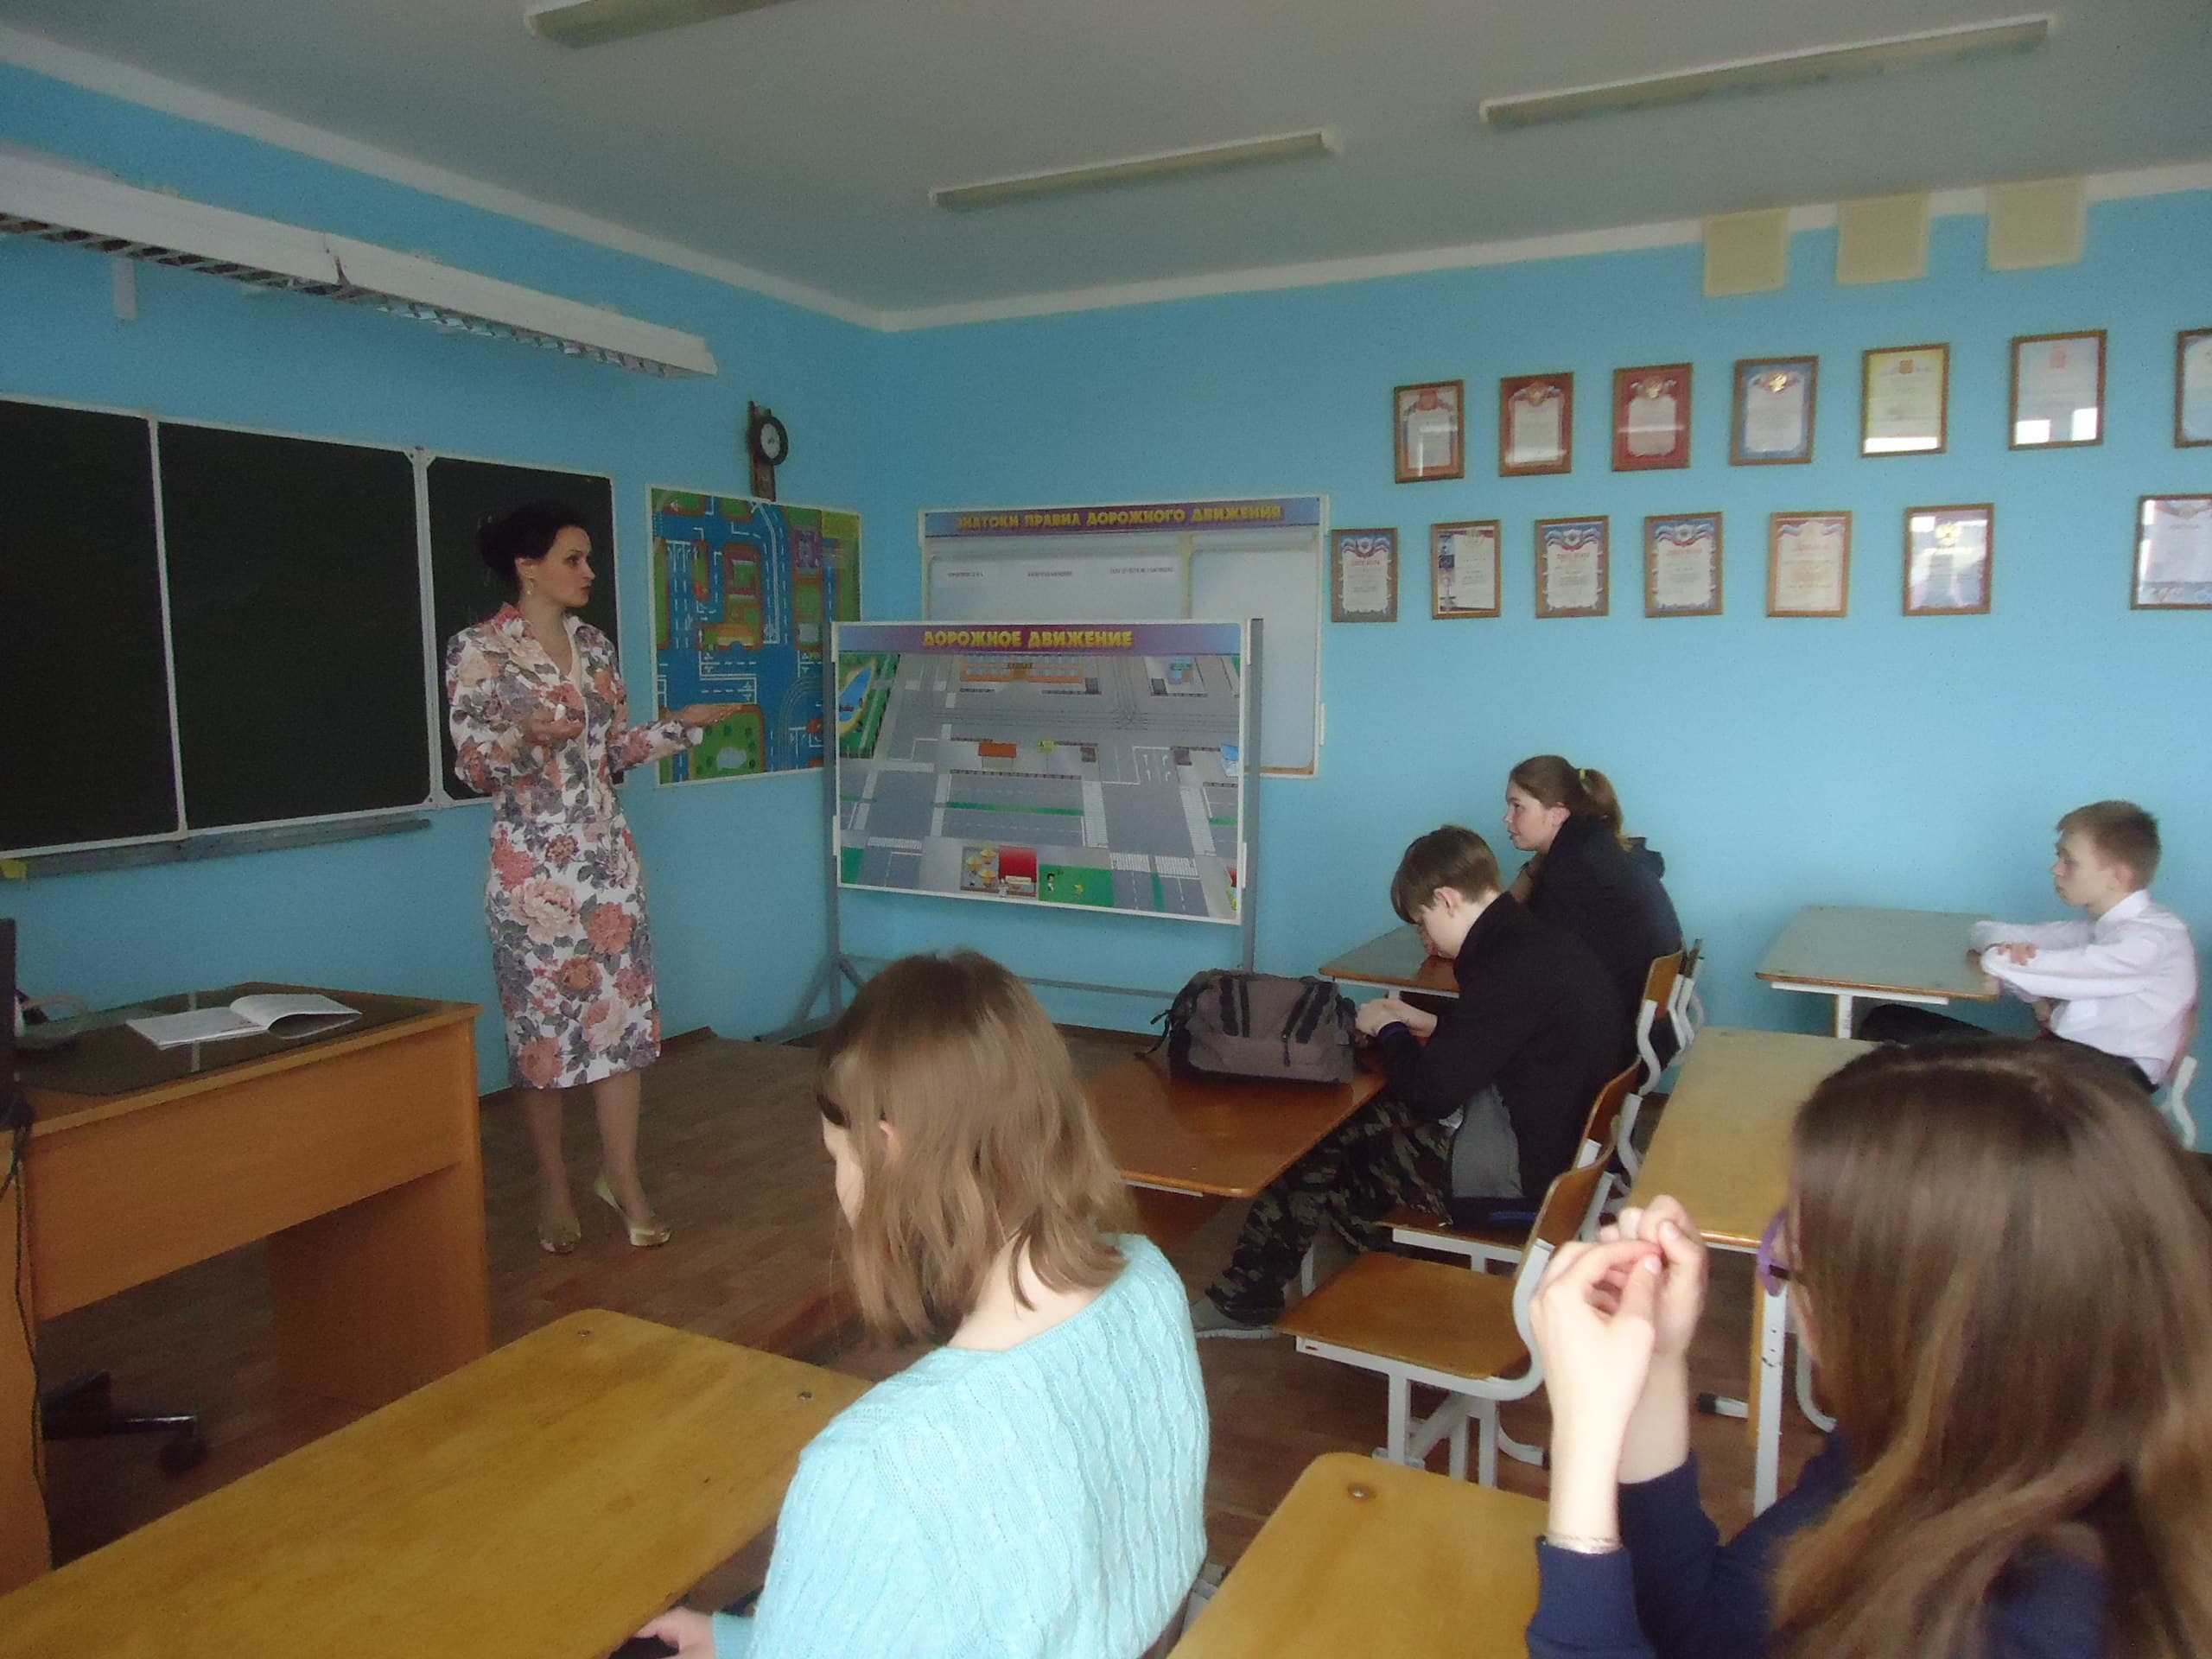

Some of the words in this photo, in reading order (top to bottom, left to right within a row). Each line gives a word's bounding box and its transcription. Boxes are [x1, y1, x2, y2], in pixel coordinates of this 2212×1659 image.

[1085, 509, 1186, 525] ДОРОЖНОГО
[923, 630, 1022, 647] ДОРОЖНОЕ
[1027, 630, 1133, 649] ДВИЖЕНИЕ
